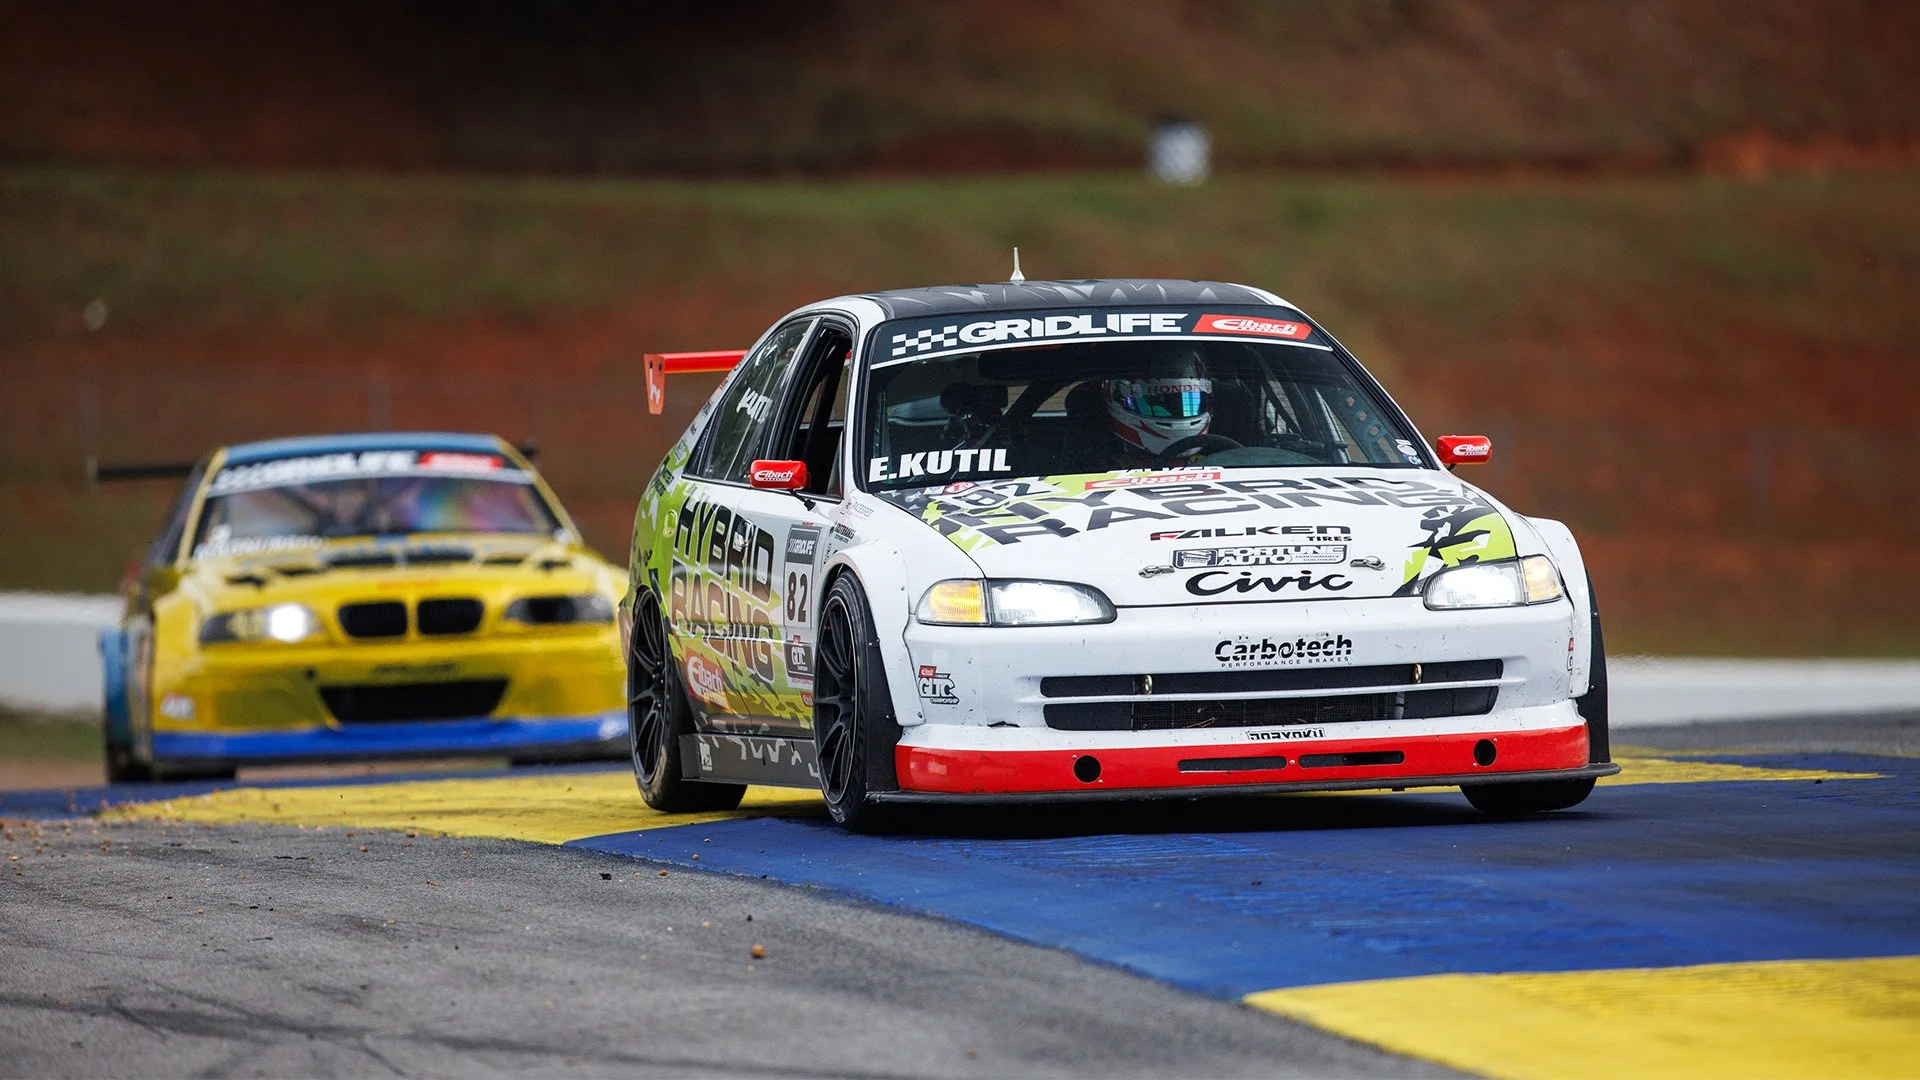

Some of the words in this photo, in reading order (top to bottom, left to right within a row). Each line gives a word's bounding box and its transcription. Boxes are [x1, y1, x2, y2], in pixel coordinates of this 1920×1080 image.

[959, 314, 1189, 343] GRIDLIFE
[1212, 318, 1298, 334] Eibach
[754, 470, 794, 482] Eibach
[868, 448, 1011, 483] E.KUTIL
[940, 477, 1438, 527] HYBRID
[976, 486, 1476, 546] RACING
[674, 486, 775, 603] HYBRID
[1151, 525, 1351, 541] FALKEN
[1218, 545, 1346, 558] FORTUNE
[1218, 554, 1292, 566] AUTO
[787, 571, 808, 622] 82
[1185, 569, 1354, 597] Civic
[1215, 635, 1352, 662] Carbotech
[1221, 659, 1301, 668] PERFORMANCE
[1308, 656, 1350, 664] BRAKES
[688, 656, 723, 697] Eibach
